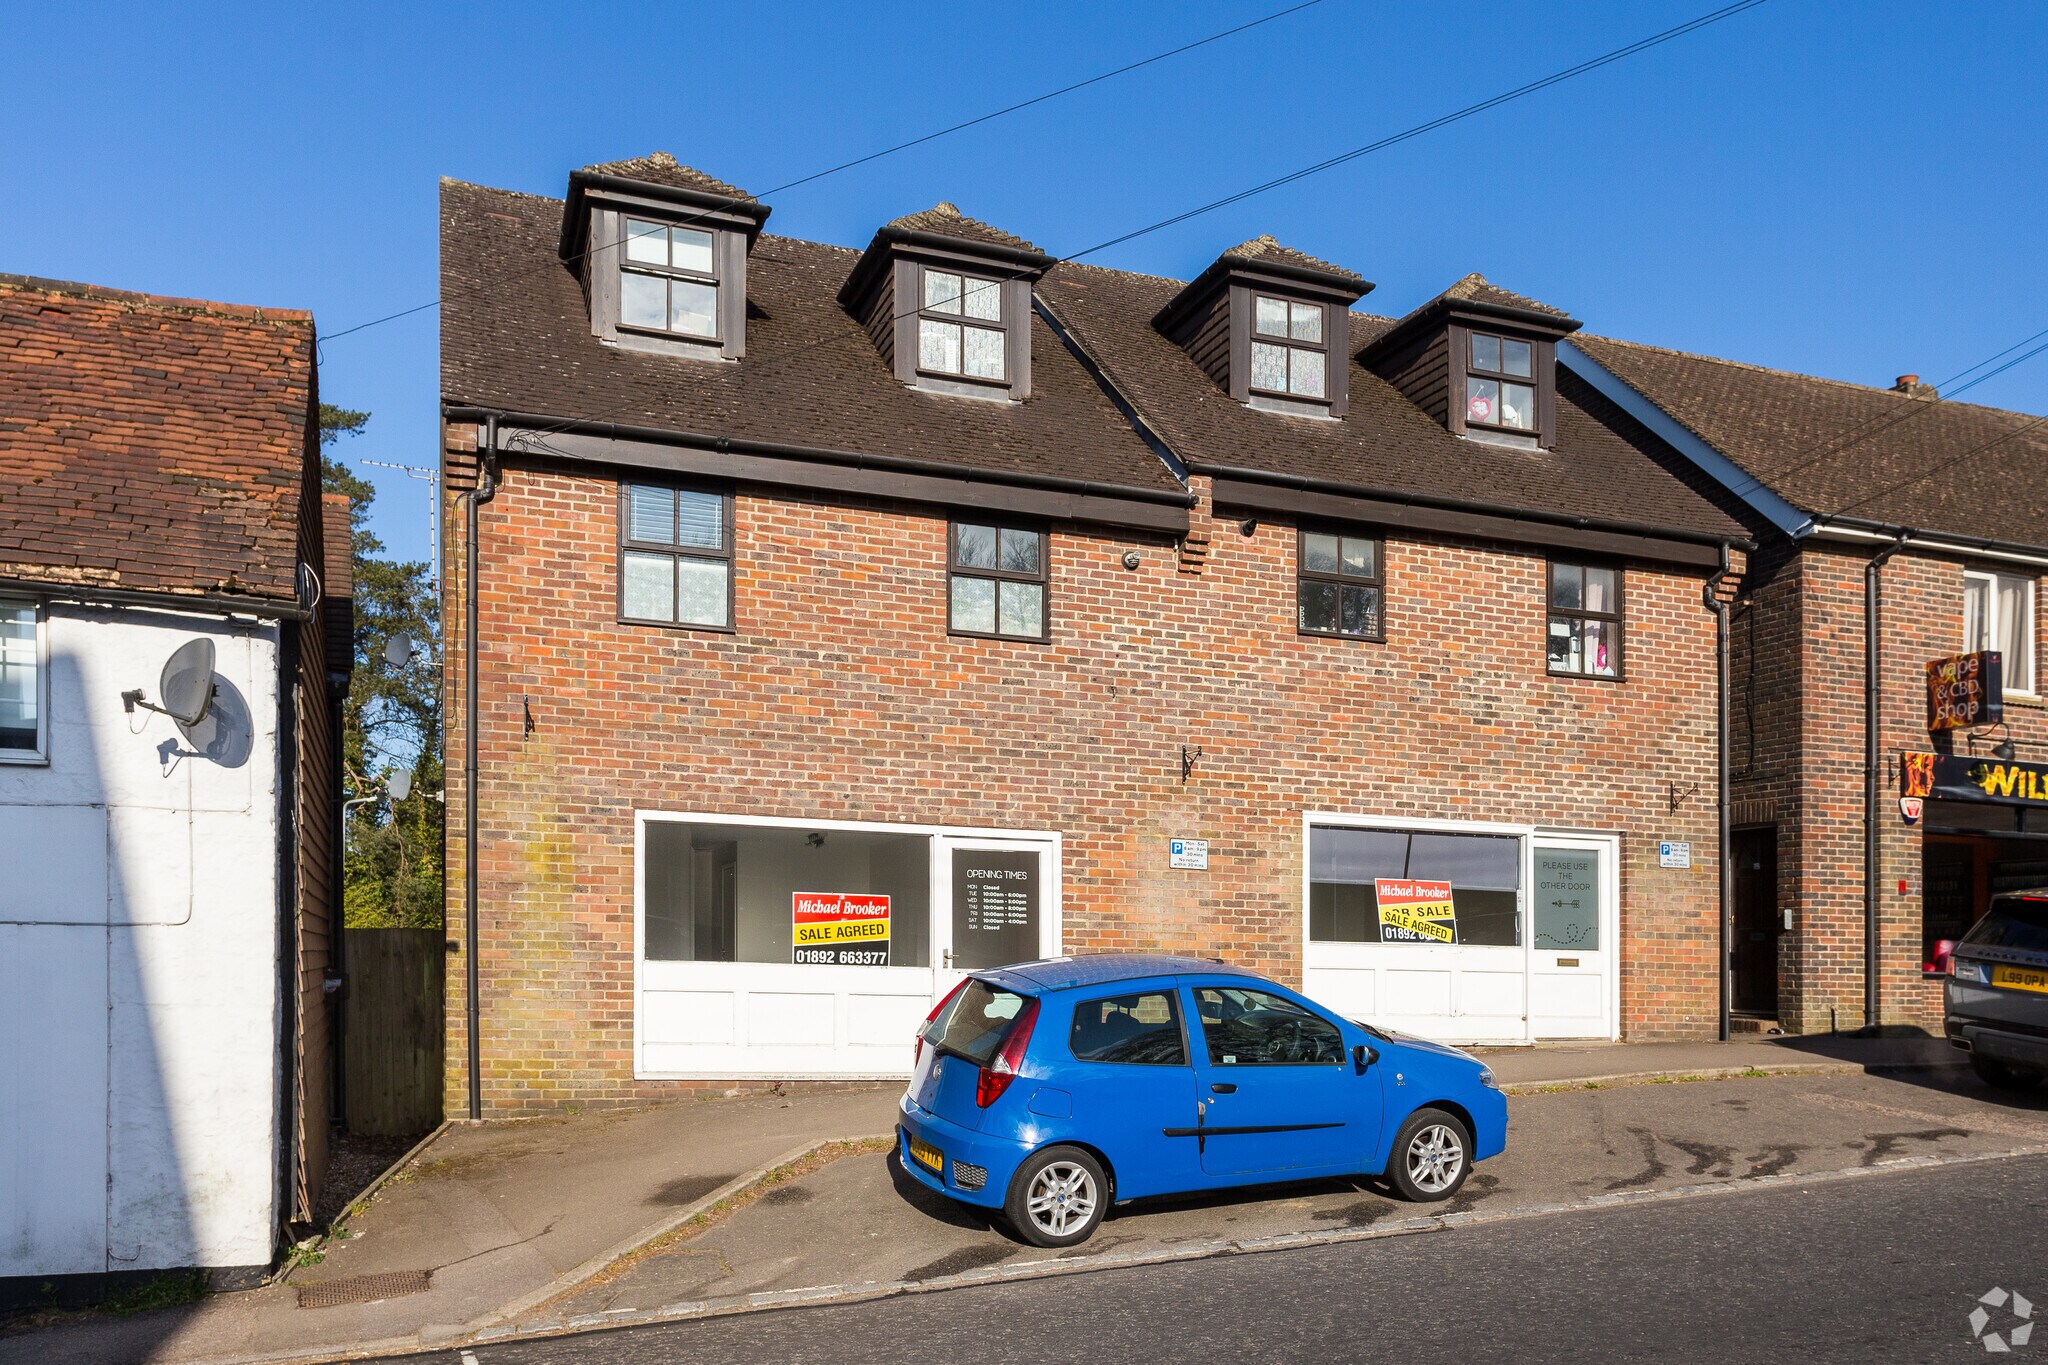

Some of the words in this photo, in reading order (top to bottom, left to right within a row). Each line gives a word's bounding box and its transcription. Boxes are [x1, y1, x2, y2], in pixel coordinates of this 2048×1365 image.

[1937, 658, 1979, 680] vape
[1937, 684, 1948, 700] &
[1949, 679, 1979, 697] CBD
[1937, 700, 1979, 721] shop
[1980, 764, 2048, 801] WIL
[1542, 861, 1572, 870] PLEASE
[1573, 862, 1588, 871] USE
[966, 869, 1003, 879] OPENING
[1004, 870, 1028, 880] TIMES
[1558, 872, 1573, 880] THE
[1380, 884, 1414, 897] Michael
[1415, 886, 1449, 899] Brooker
[1540, 881, 1567, 890] OTHER
[1567, 882, 1591, 891] DOOR
[797, 899, 841, 914] Michael
[842, 900, 887, 916] Brooker
[1416, 905, 1451, 917] SALE
[799, 927, 832, 941] SALE
[836, 923, 885, 938] AGREED
[1384, 911, 1409, 927] SALE
[1411, 919, 1448, 939] AGREED
[1385, 927, 1416, 940] 01892
[796, 949, 835, 964] 01892
[839, 950, 887, 965] 663377
[2002, 970, 2023, 984] L99
[2024, 974, 2046, 988] OPA
